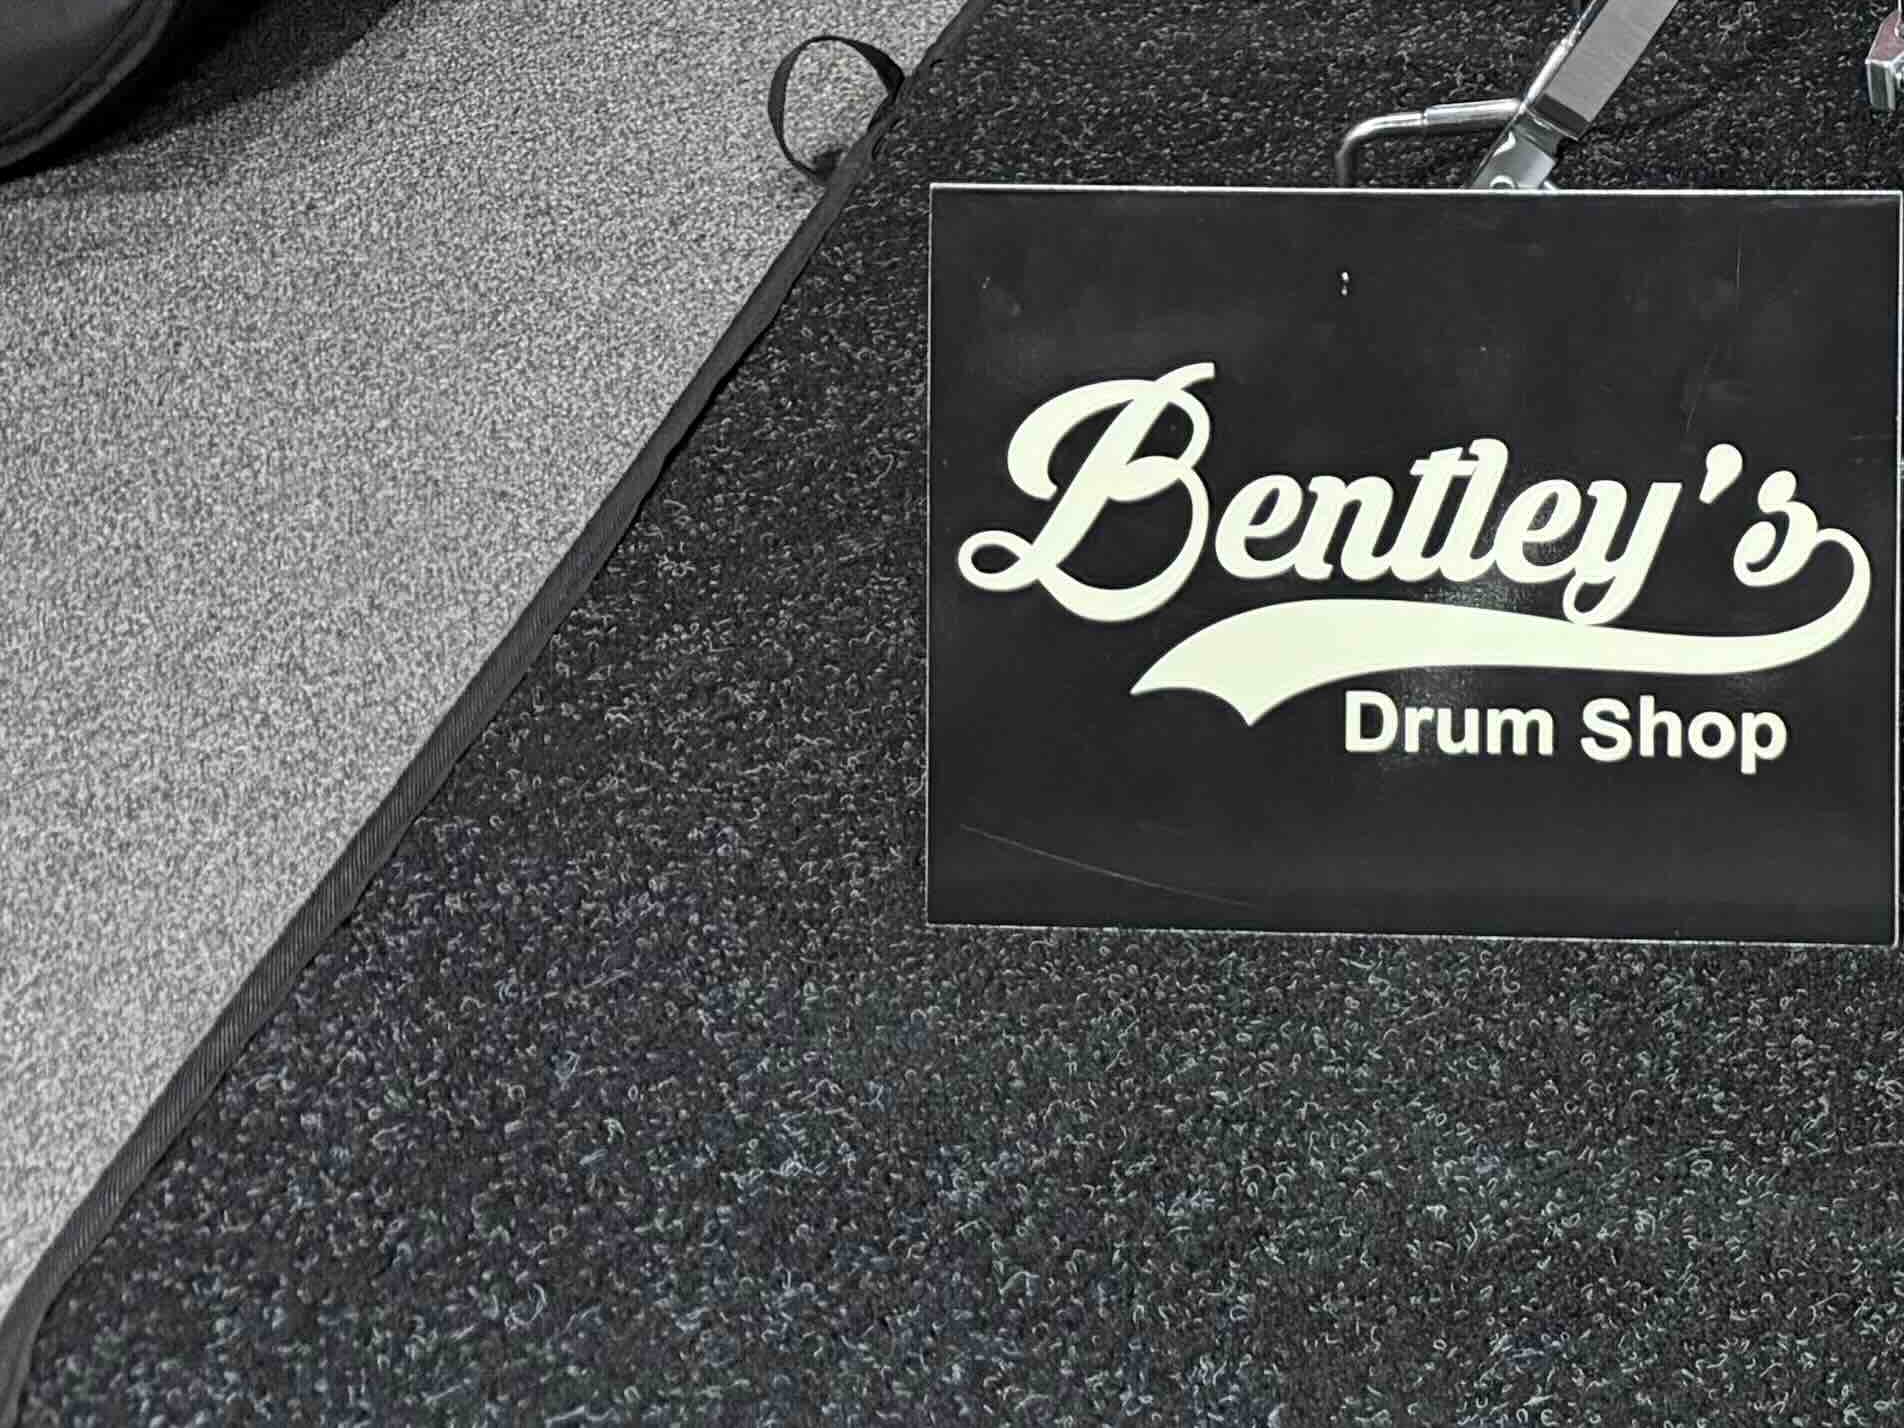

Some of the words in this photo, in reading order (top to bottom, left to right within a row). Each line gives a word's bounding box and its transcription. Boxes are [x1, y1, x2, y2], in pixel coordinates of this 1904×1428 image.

[957, 361, 1870, 626] Bentley's
[1343, 693, 1555, 757] Drum
[1580, 697, 1788, 775] Shop
